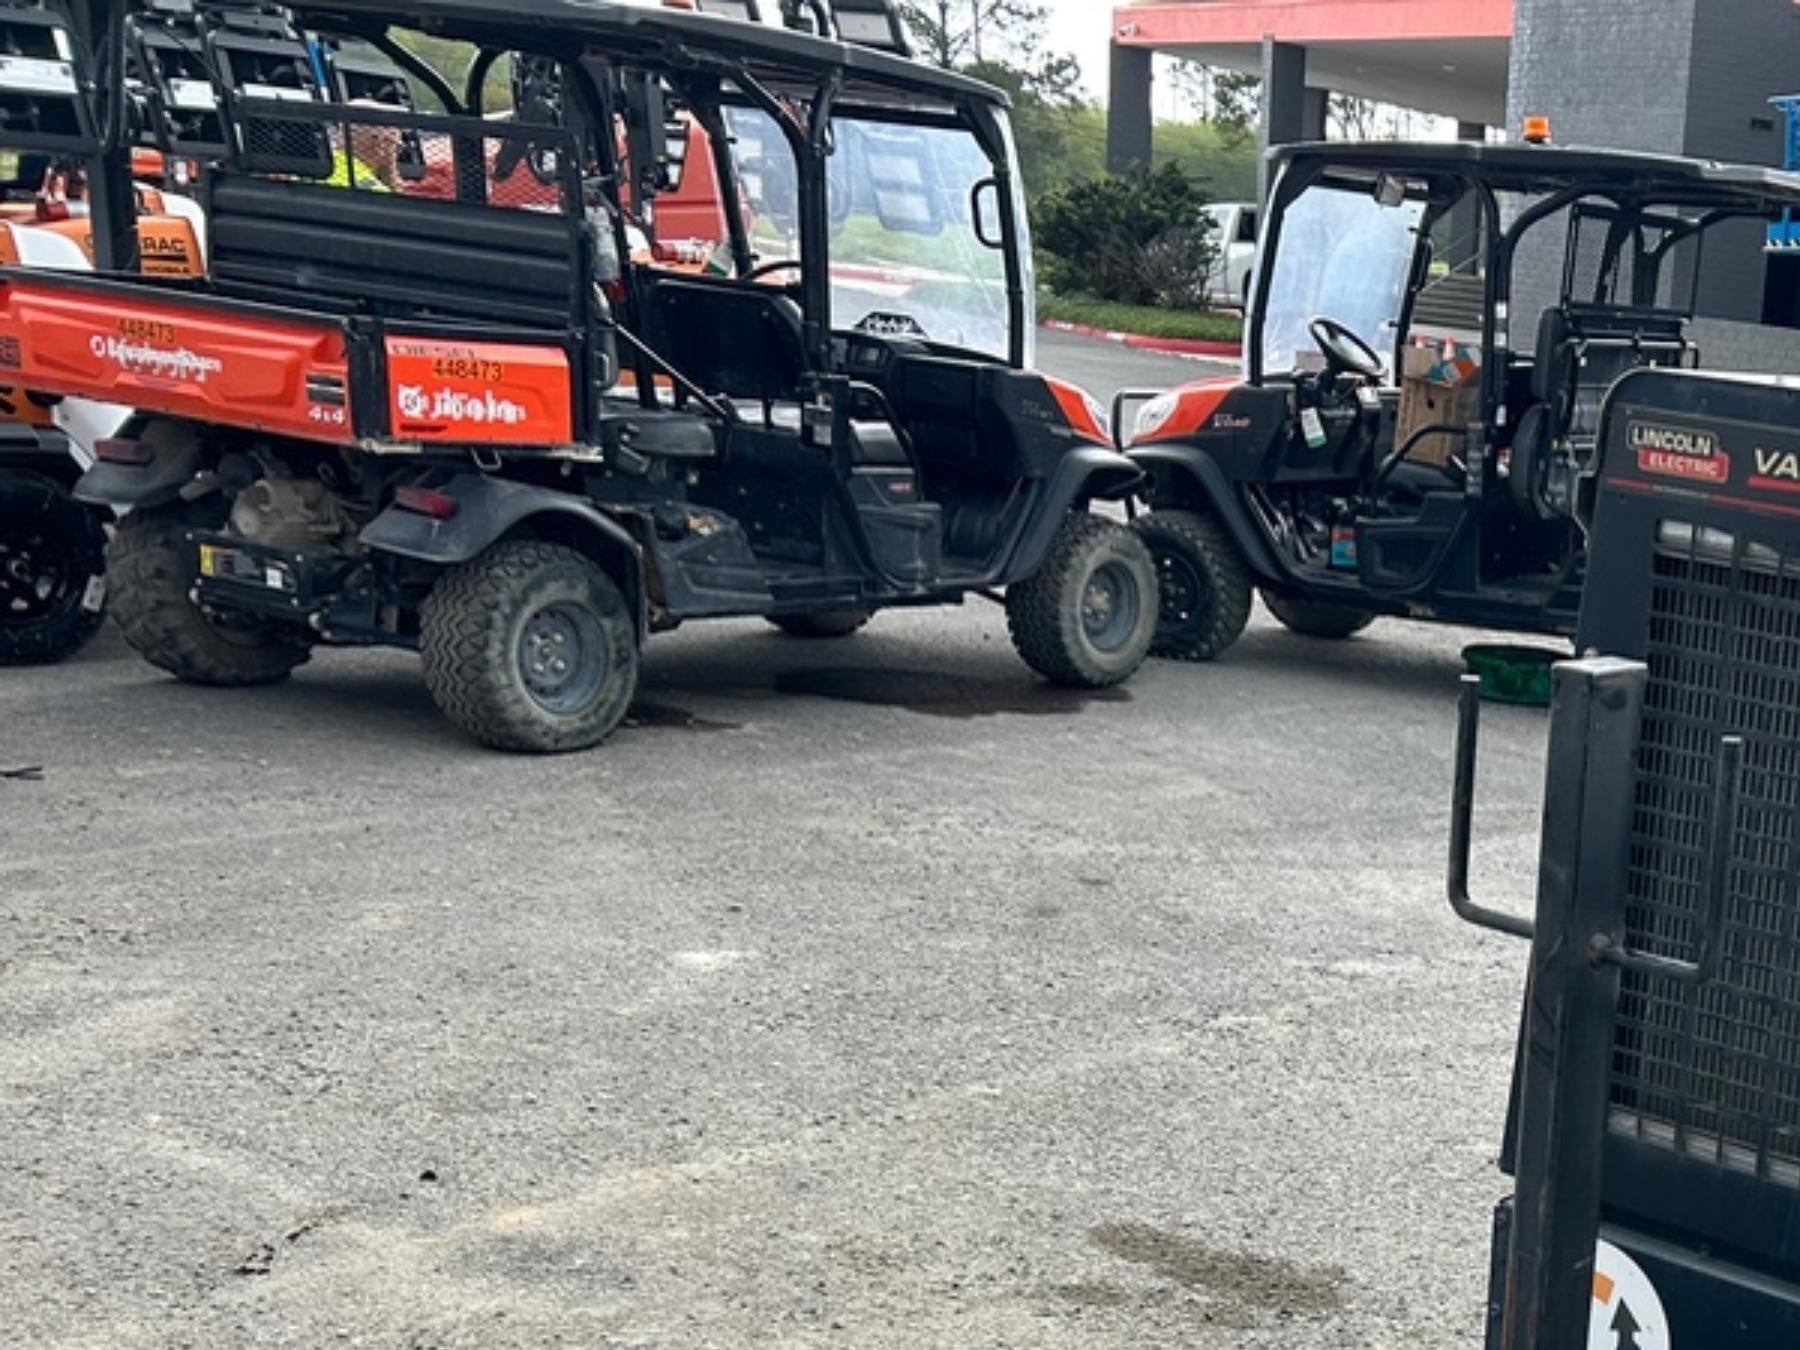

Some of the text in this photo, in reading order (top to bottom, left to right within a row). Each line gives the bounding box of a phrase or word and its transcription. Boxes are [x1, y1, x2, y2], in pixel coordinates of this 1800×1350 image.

[432, 359, 502, 382] 448473
[1632, 427, 1712, 455] LINCOLN
[1649, 453, 1719, 477] ELECTRIC
